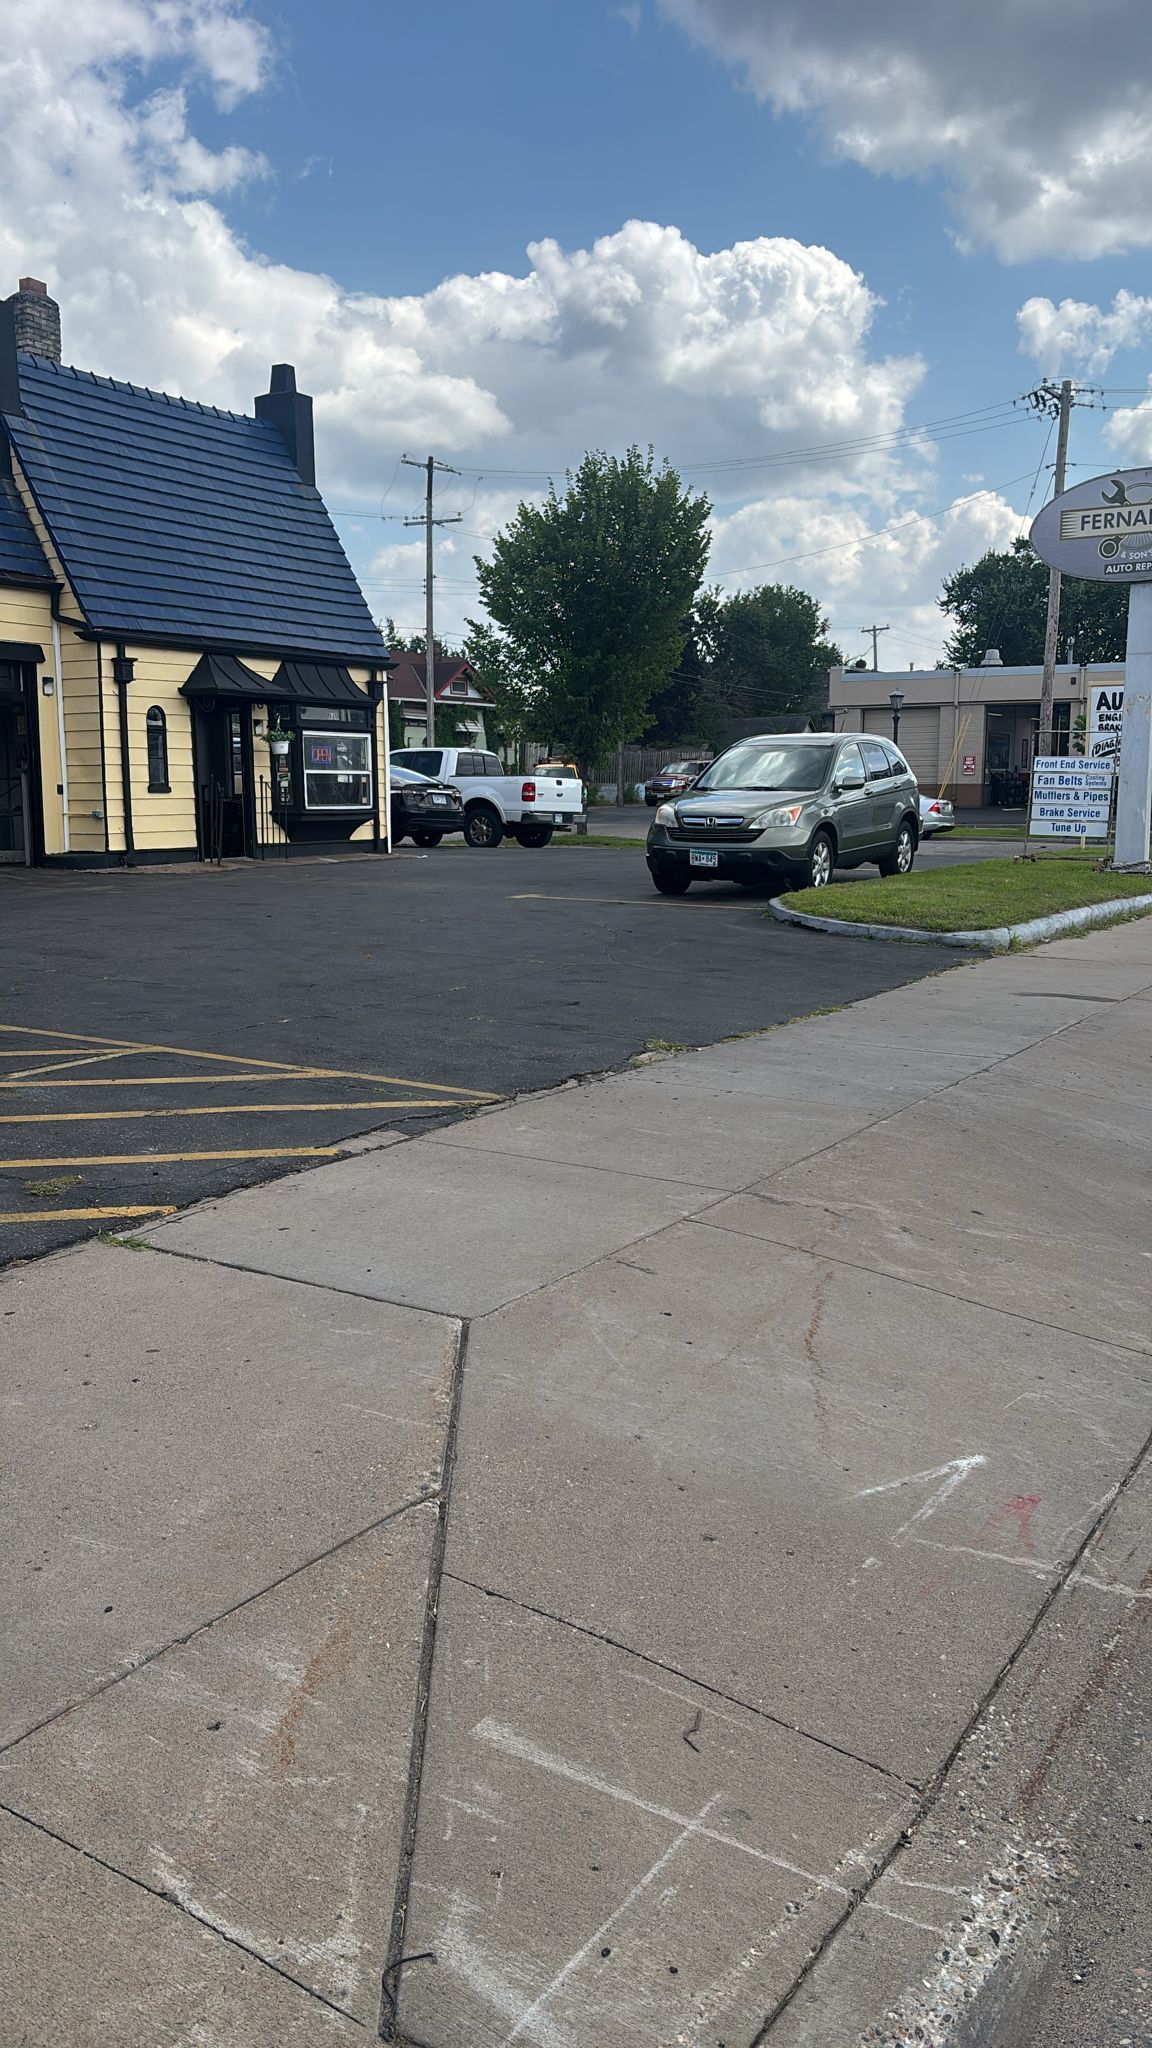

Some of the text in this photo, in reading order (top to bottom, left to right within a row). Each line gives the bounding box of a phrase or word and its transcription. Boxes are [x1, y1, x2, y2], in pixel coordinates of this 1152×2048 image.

[1105, 563, 1133, 574] AUTO
[1036, 760, 1058, 769] Front
[1060, 760, 1076, 769] End
[1078, 760, 1111, 770] Service
[1037, 775, 1083, 786] Fan Belts
[1034, 791, 1109, 803] Mufflers & Pipes
[1039, 807, 1101, 818] Brake Service
[1051, 823, 1087, 834] Tune Up
